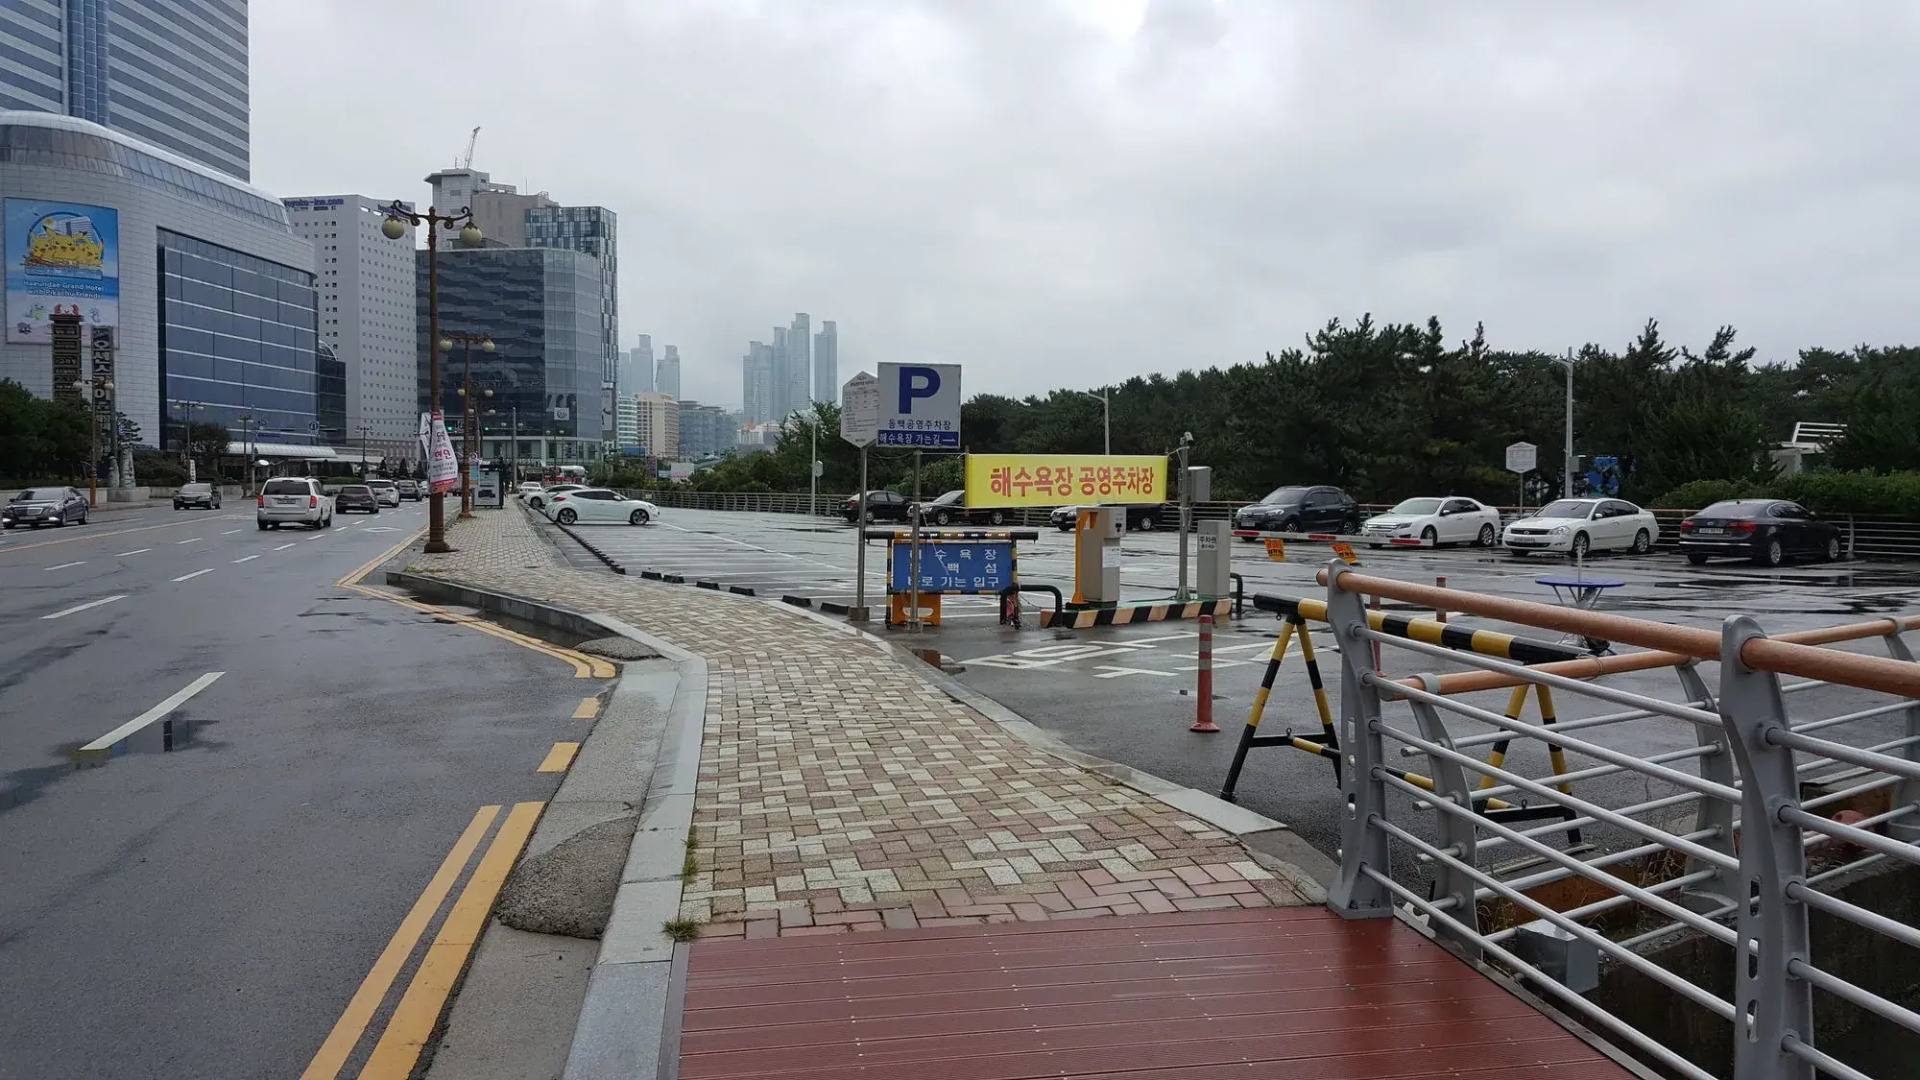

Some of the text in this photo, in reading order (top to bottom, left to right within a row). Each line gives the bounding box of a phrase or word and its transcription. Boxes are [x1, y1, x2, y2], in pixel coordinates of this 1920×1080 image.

[898, 366, 941, 414] P
[879, 432, 941, 445] 해수욕장 가는길
[990, 466, 1154, 497] 해수욕장 공영주차장
[940, 576, 967, 588] 가는
[973, 576, 1000, 588] 입구
